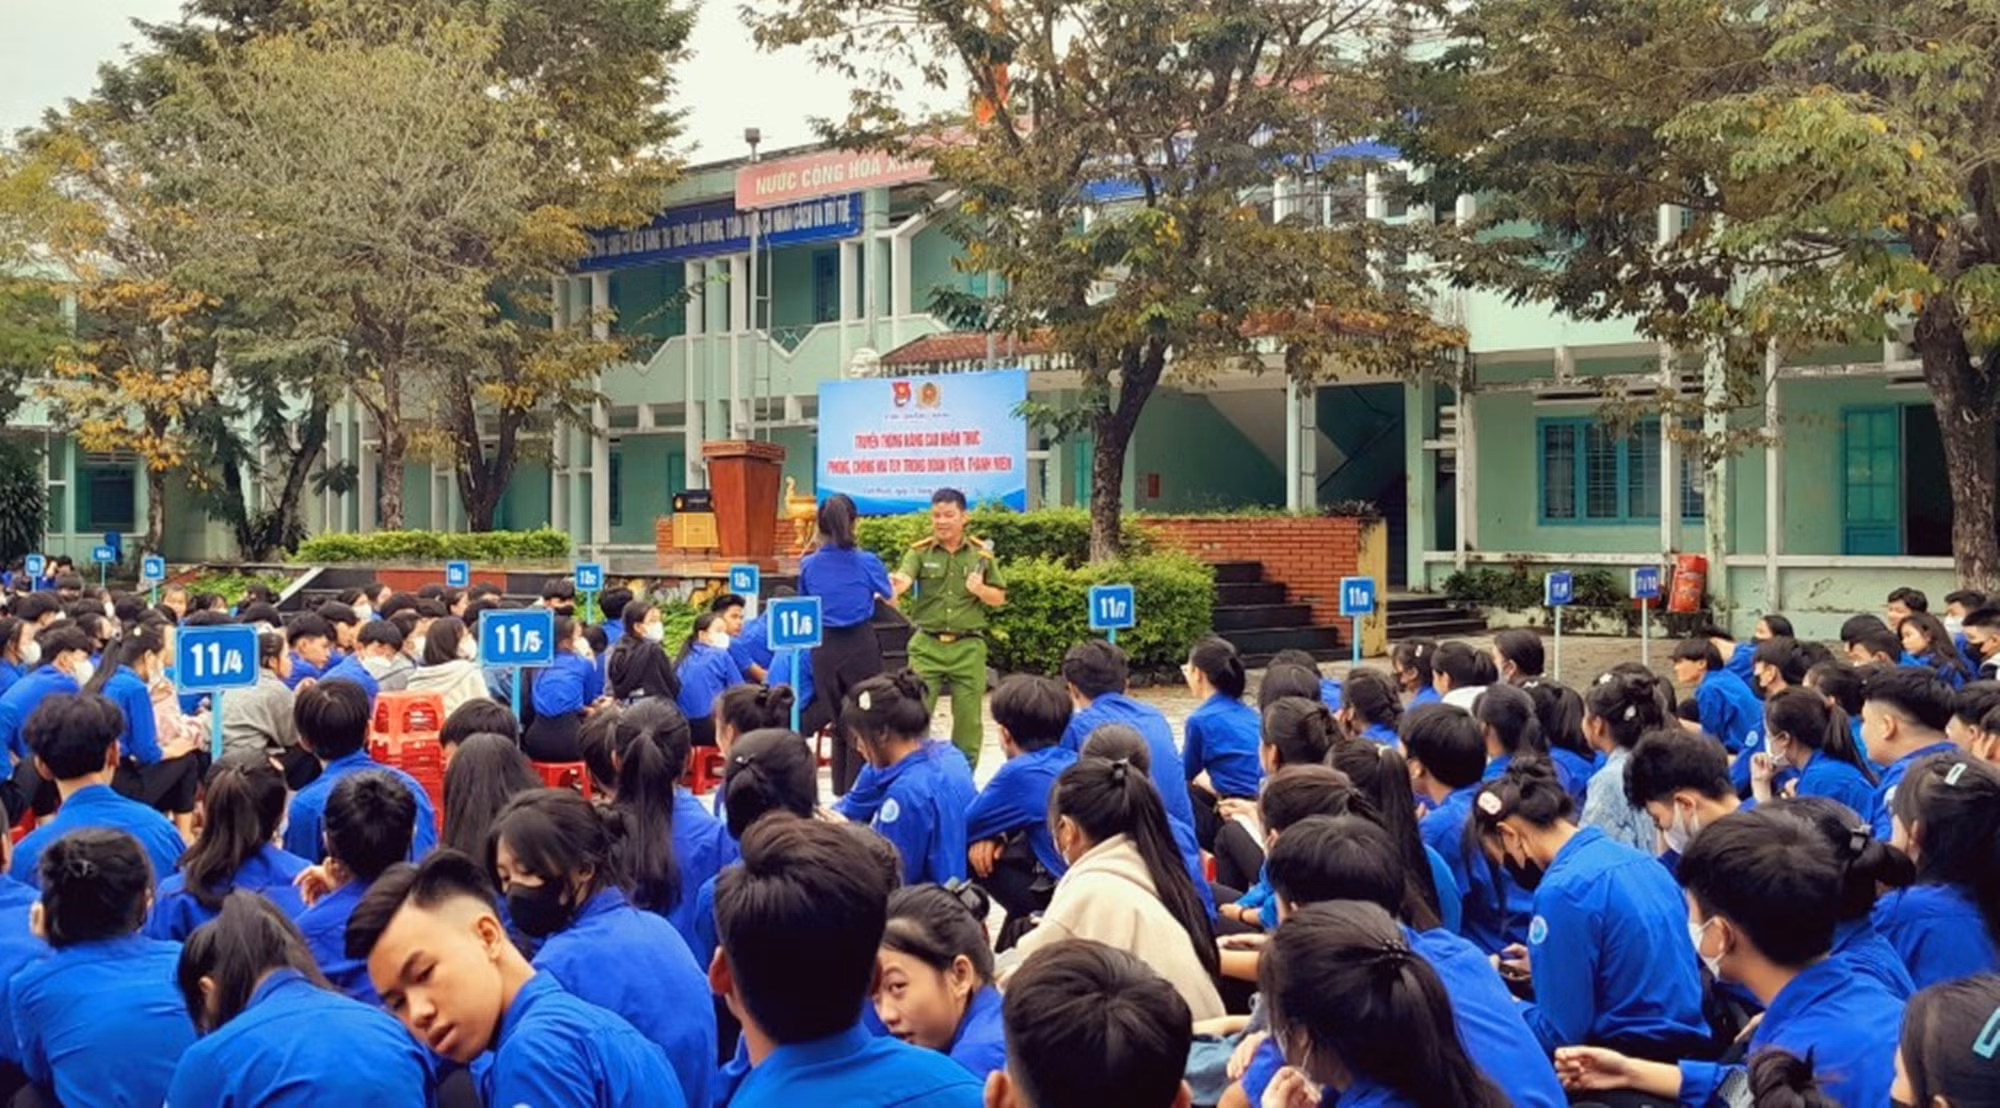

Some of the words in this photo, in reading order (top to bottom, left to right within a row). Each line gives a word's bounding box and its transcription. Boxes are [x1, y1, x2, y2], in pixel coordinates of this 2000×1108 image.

[802, 163, 844, 190] CỘNG
[1098, 596, 1126, 619] 11/7
[779, 610, 812, 637] 11/6
[494, 623, 543, 655] 11/5
[190, 641, 244, 676] 11/4
